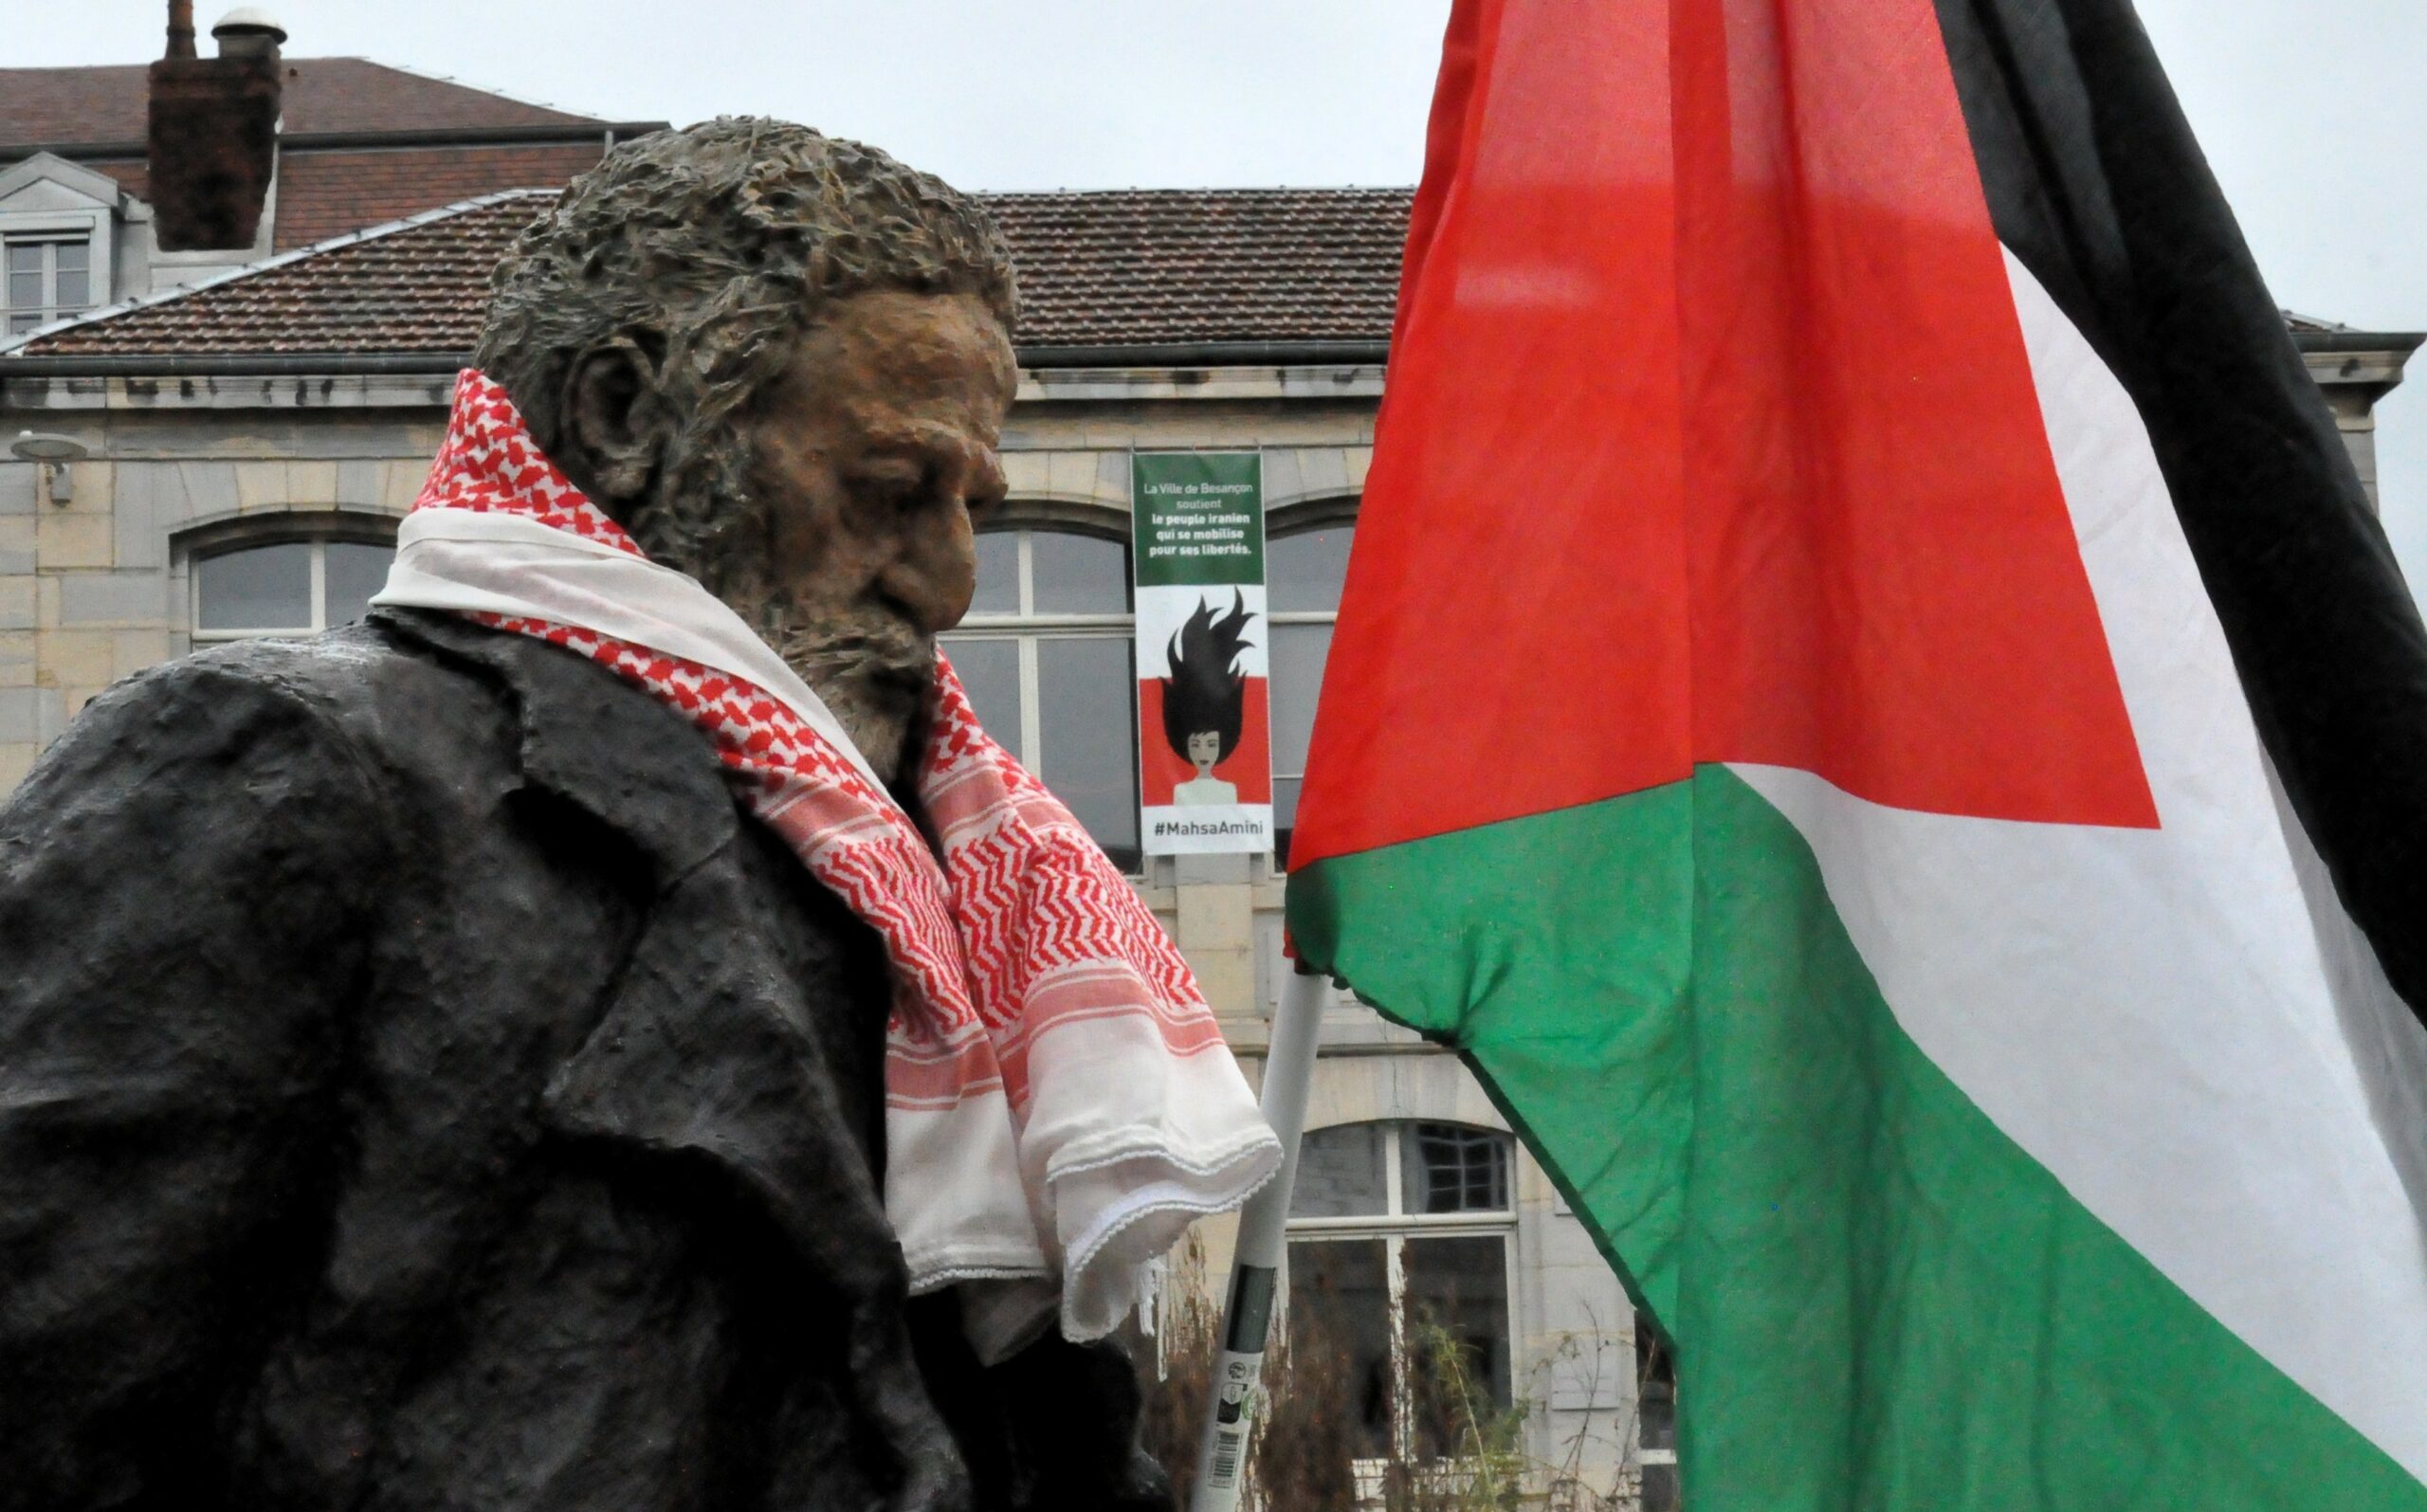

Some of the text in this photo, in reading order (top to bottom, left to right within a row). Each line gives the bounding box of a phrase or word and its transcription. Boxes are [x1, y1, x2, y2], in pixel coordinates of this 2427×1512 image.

[1144, 483, 1253, 495] La Ville de Besançon
[1176, 499, 1222, 509] soutient
[1152, 513, 1250, 525] le peuple iranien
[1157, 528, 1245, 541] qui se mobilise
[1149, 542, 1251, 557] pour ses libertés.
[1155, 821, 1263, 836] #MahsaAmini
